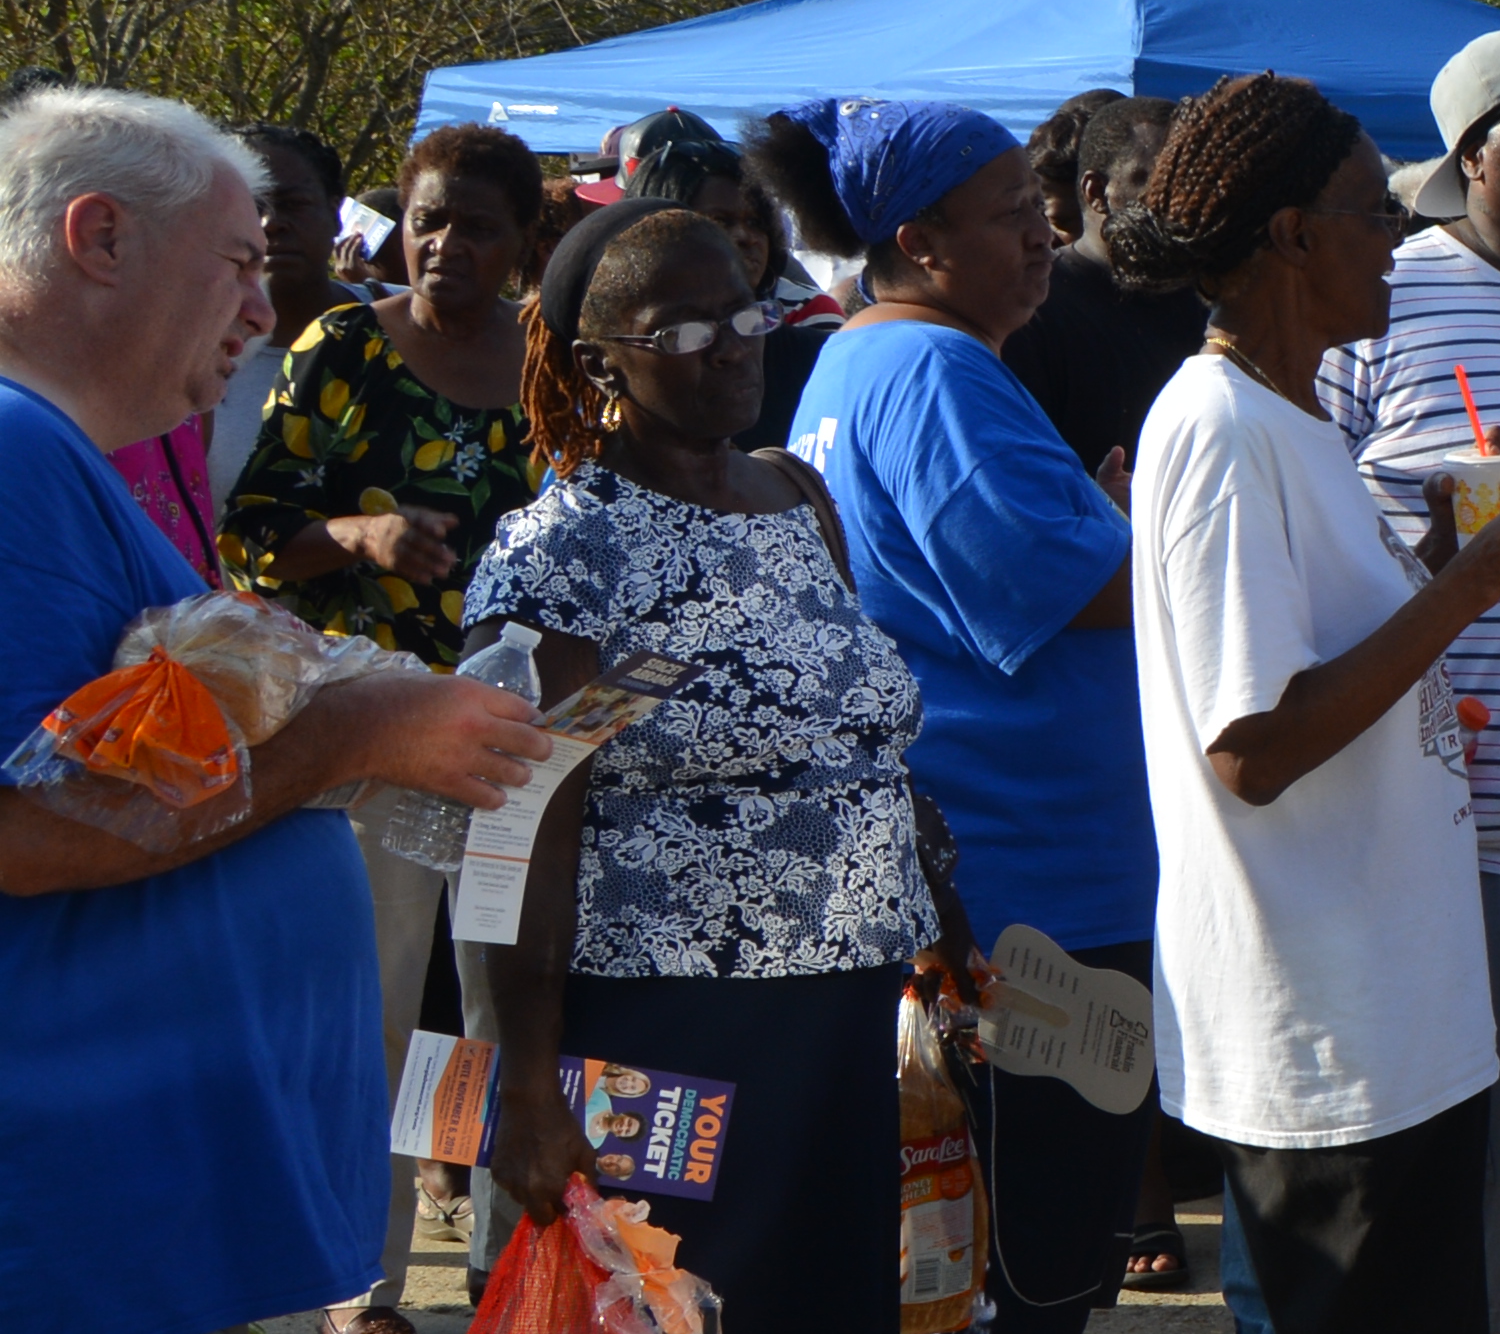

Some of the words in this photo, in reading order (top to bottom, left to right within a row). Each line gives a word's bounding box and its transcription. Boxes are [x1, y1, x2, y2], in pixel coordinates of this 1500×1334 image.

[461, 1059, 472, 1078] VOTE
[1110, 1030, 1128, 1072] Financial
[1122, 1035, 1140, 1074] Franklin
[452, 1080, 468, 1126] NOVEMBER
[443, 1132, 456, 1155] 2018
[643, 1086, 682, 1179] TICKET
[667, 1088, 697, 1181] DEMOCRATIC
[684, 1094, 727, 1184] YOUR
[900, 1145, 939, 1176] Sara
[938, 1136, 965, 1163] Lee
[901, 1176, 932, 1194] ONEY
